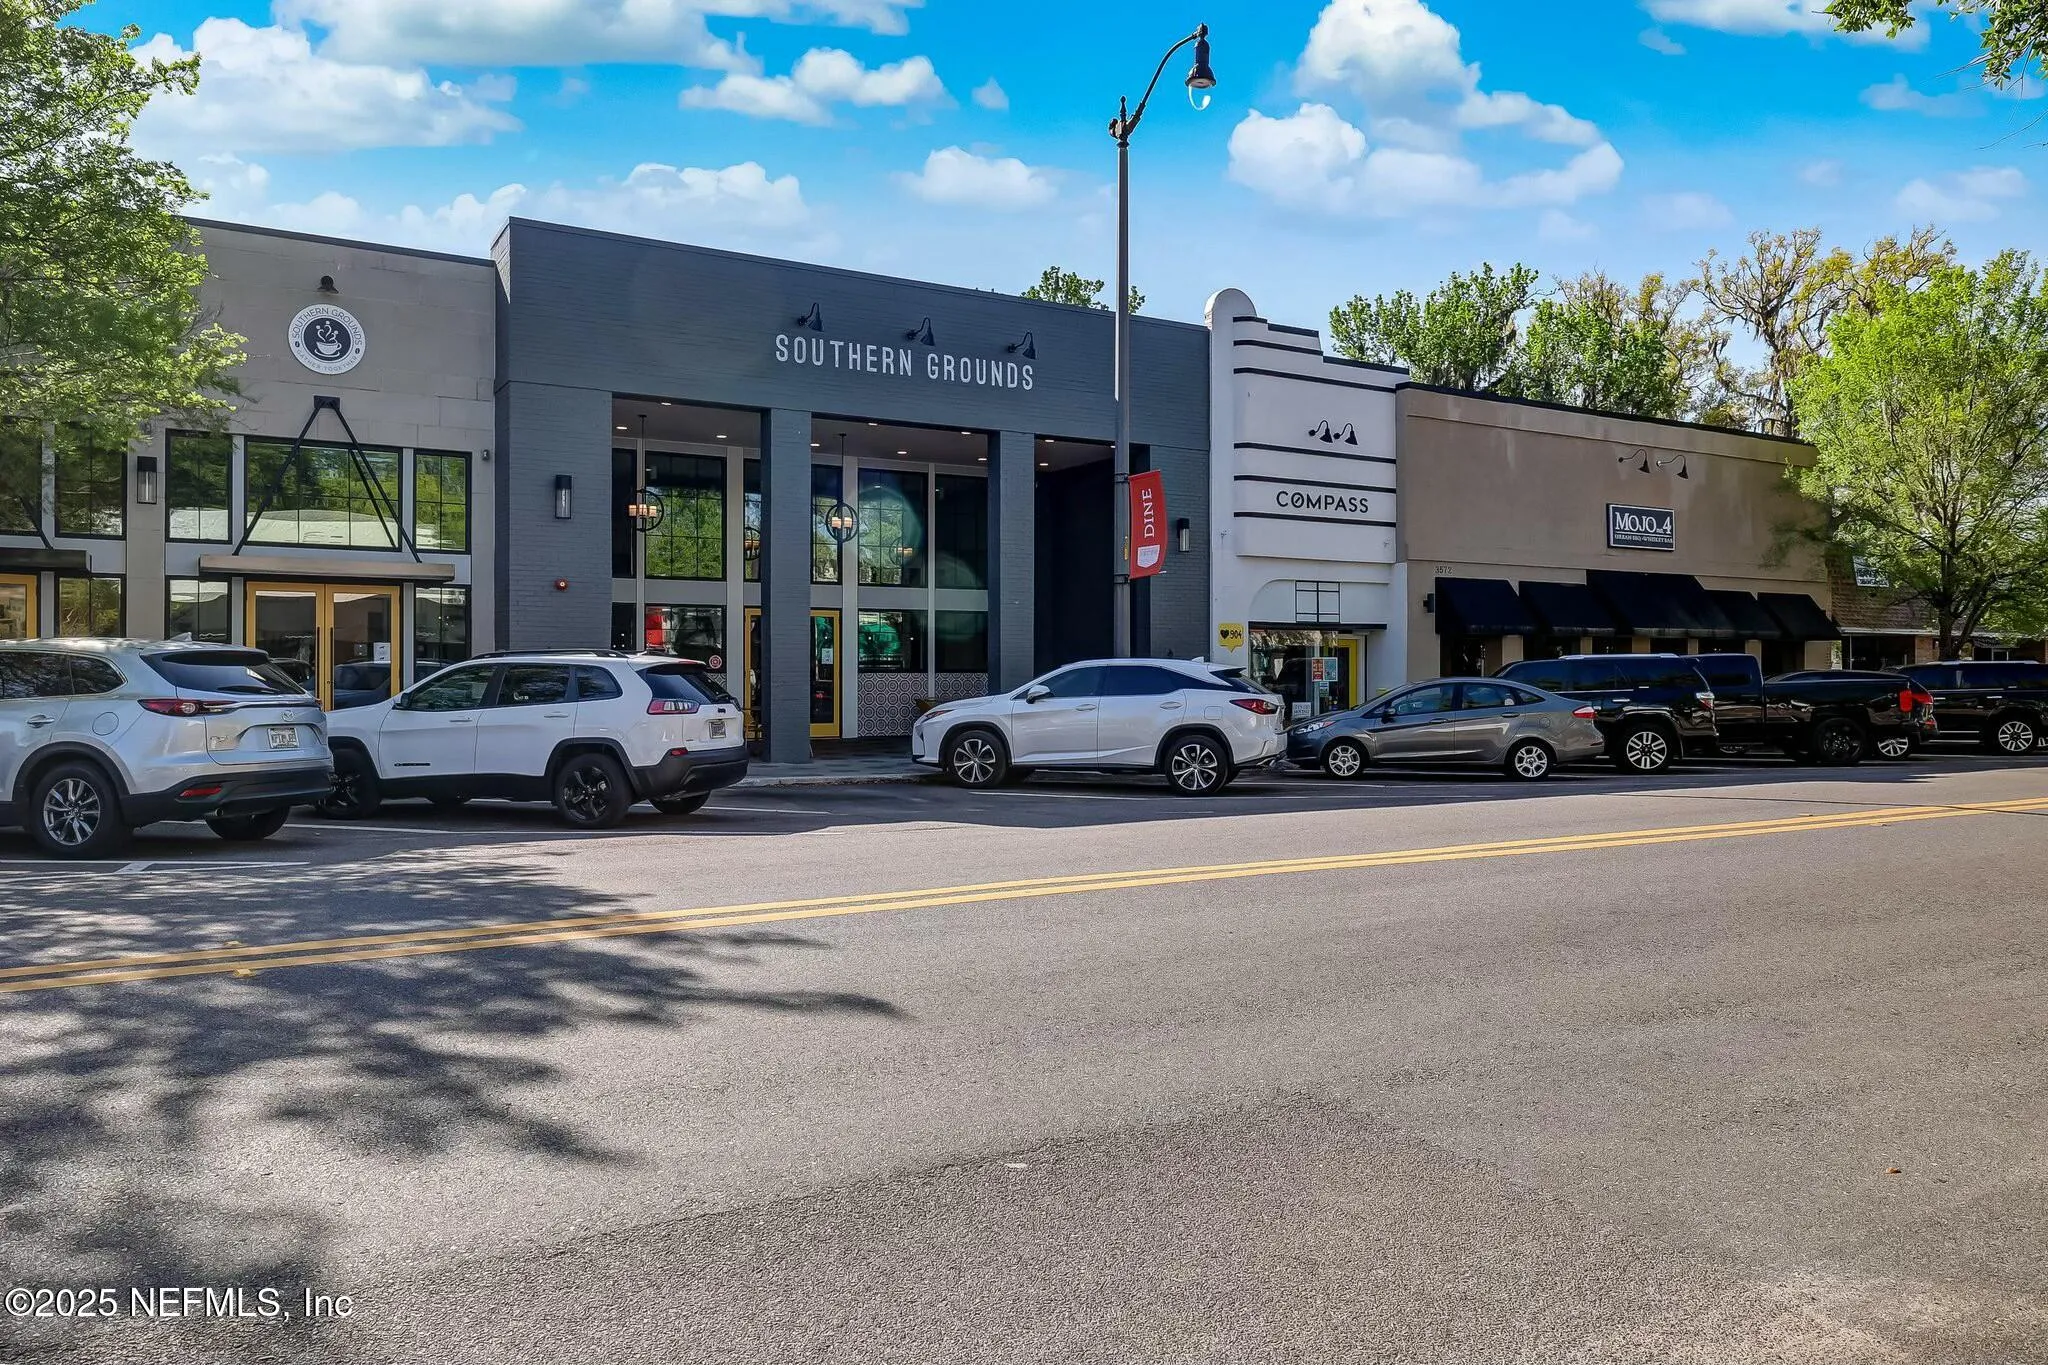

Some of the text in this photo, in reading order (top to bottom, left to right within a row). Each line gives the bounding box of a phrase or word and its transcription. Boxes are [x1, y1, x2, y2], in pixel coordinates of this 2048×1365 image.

[293, 308, 362, 346] SOUTHERN GROUNDS
[775, 334, 1033, 391] SOUTHERN GROUNDS
[1142, 488, 1155, 539] DINE
[1276, 490, 1369, 514] COMPASS
[1615, 511, 1657, 533] MOJO
[1662, 516, 1672, 535] 4
[1230, 629, 1242, 640] 904
